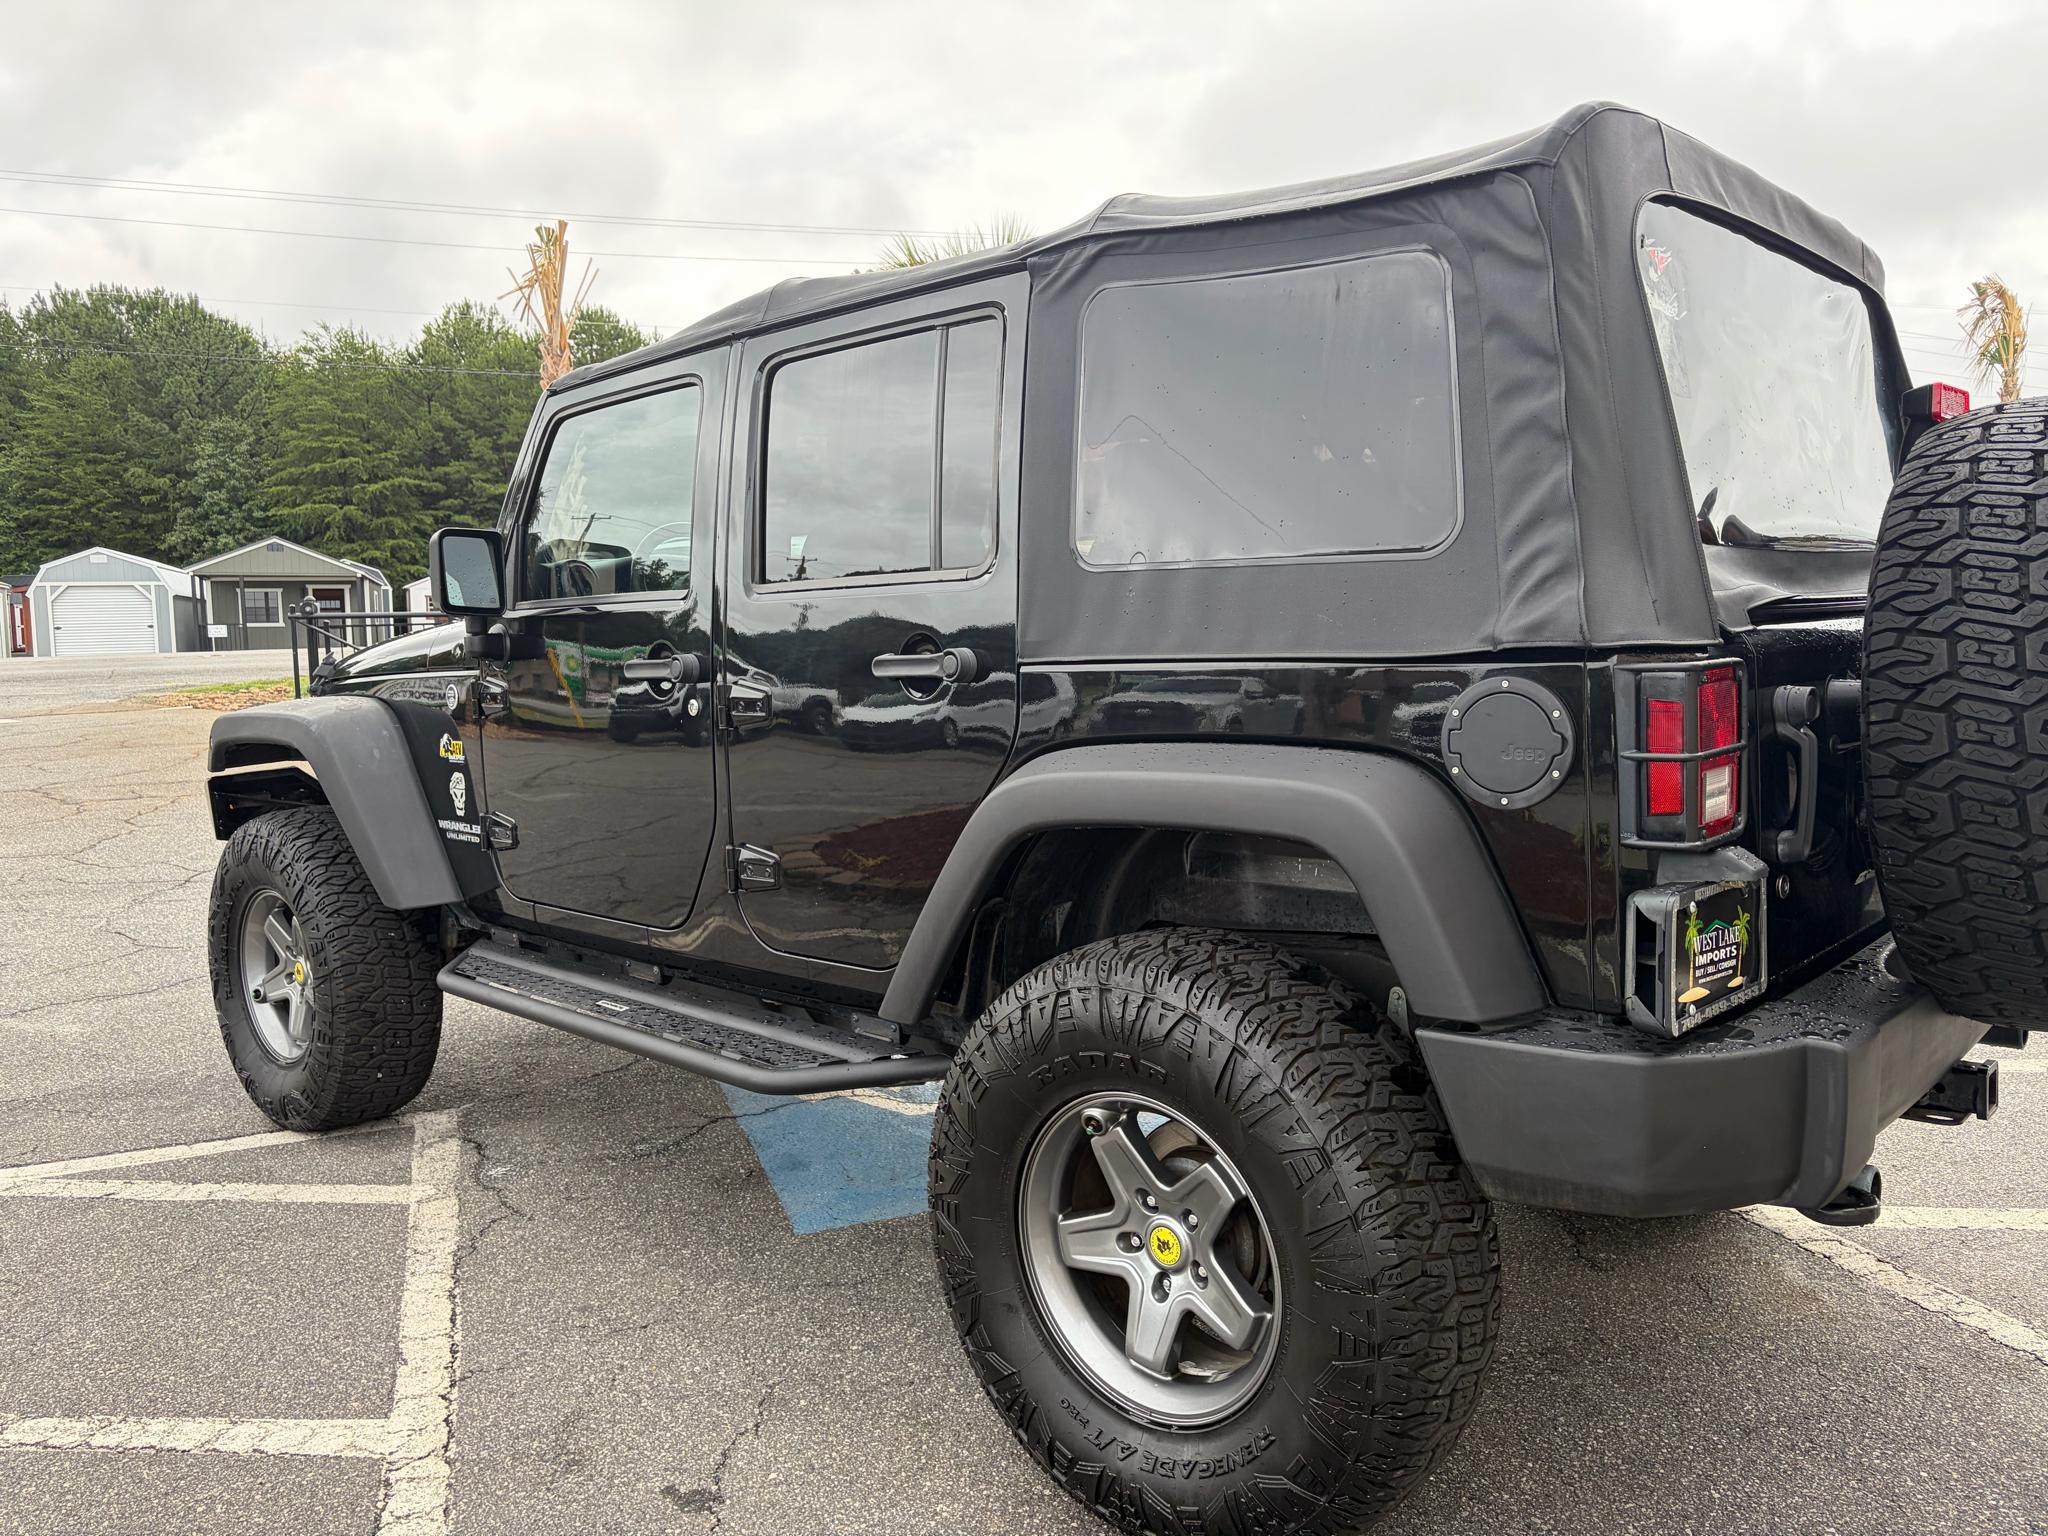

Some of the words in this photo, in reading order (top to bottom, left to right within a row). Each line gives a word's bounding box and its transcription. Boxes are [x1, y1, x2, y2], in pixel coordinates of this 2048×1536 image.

[1500, 743, 1546, 767] Jeep
[446, 831, 480, 843] UNLIMITED
[1694, 932, 1717, 954] WEST
[1719, 926, 1740, 946] LAKE
[1695, 945, 1737, 967] IMPORTS
[1695, 969, 1705, 978] BUY
[1707, 965, 1717, 974] SELL
[1027, 1051, 1168, 1091] RADAR
[1059, 1397, 1091, 1430] PRO
[1138, 1424, 1277, 1480] RENEGADE
